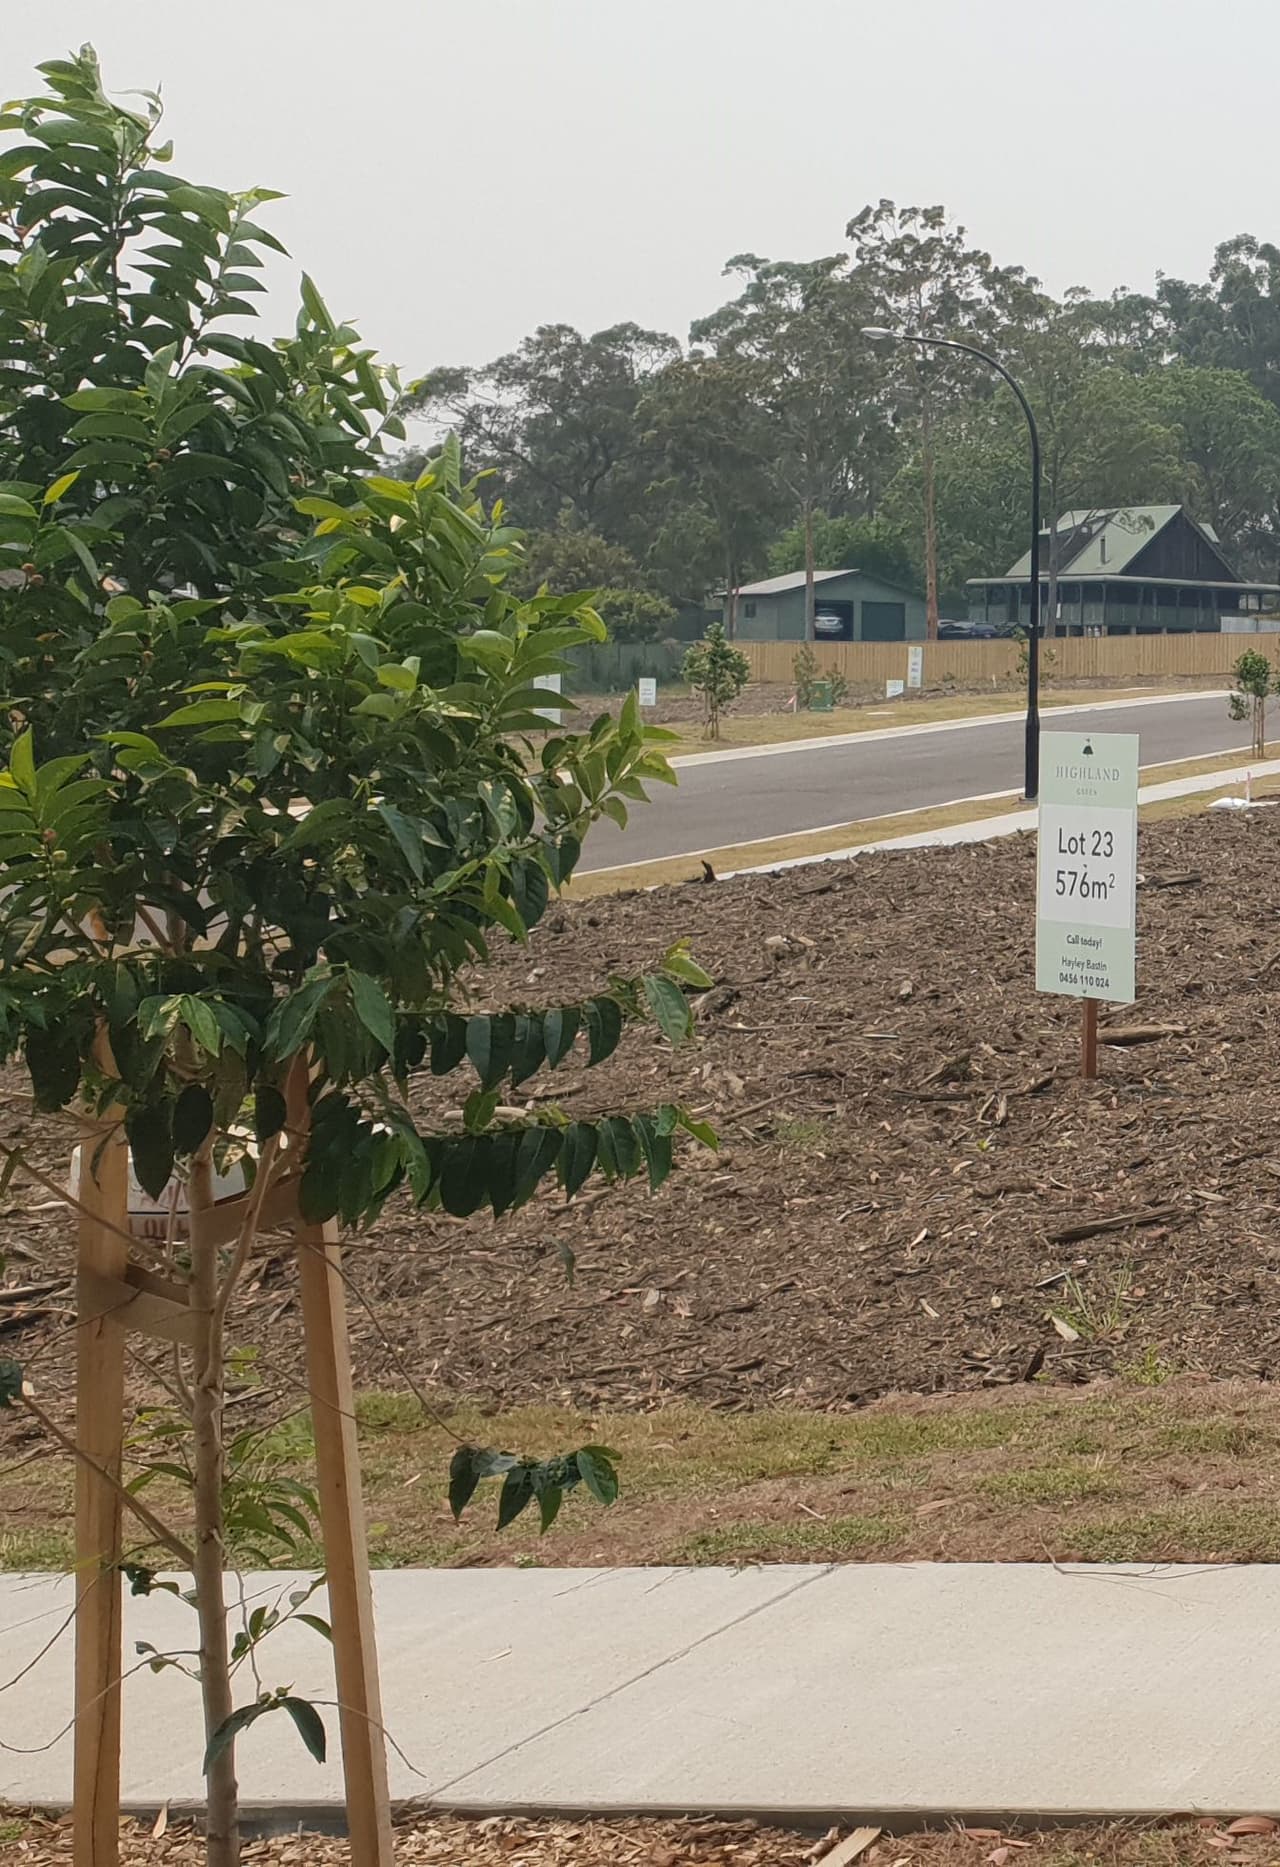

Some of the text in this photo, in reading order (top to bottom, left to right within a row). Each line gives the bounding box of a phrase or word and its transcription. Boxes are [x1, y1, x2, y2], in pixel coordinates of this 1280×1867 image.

[1056, 766, 1120, 781] HIGHLAND
[1059, 827, 1114, 858] Lot 23
[1066, 934, 1103, 950] Call today!
[1061, 955, 1085, 972] Hayley
[1059, 972, 1110, 988] 0456 110 024
